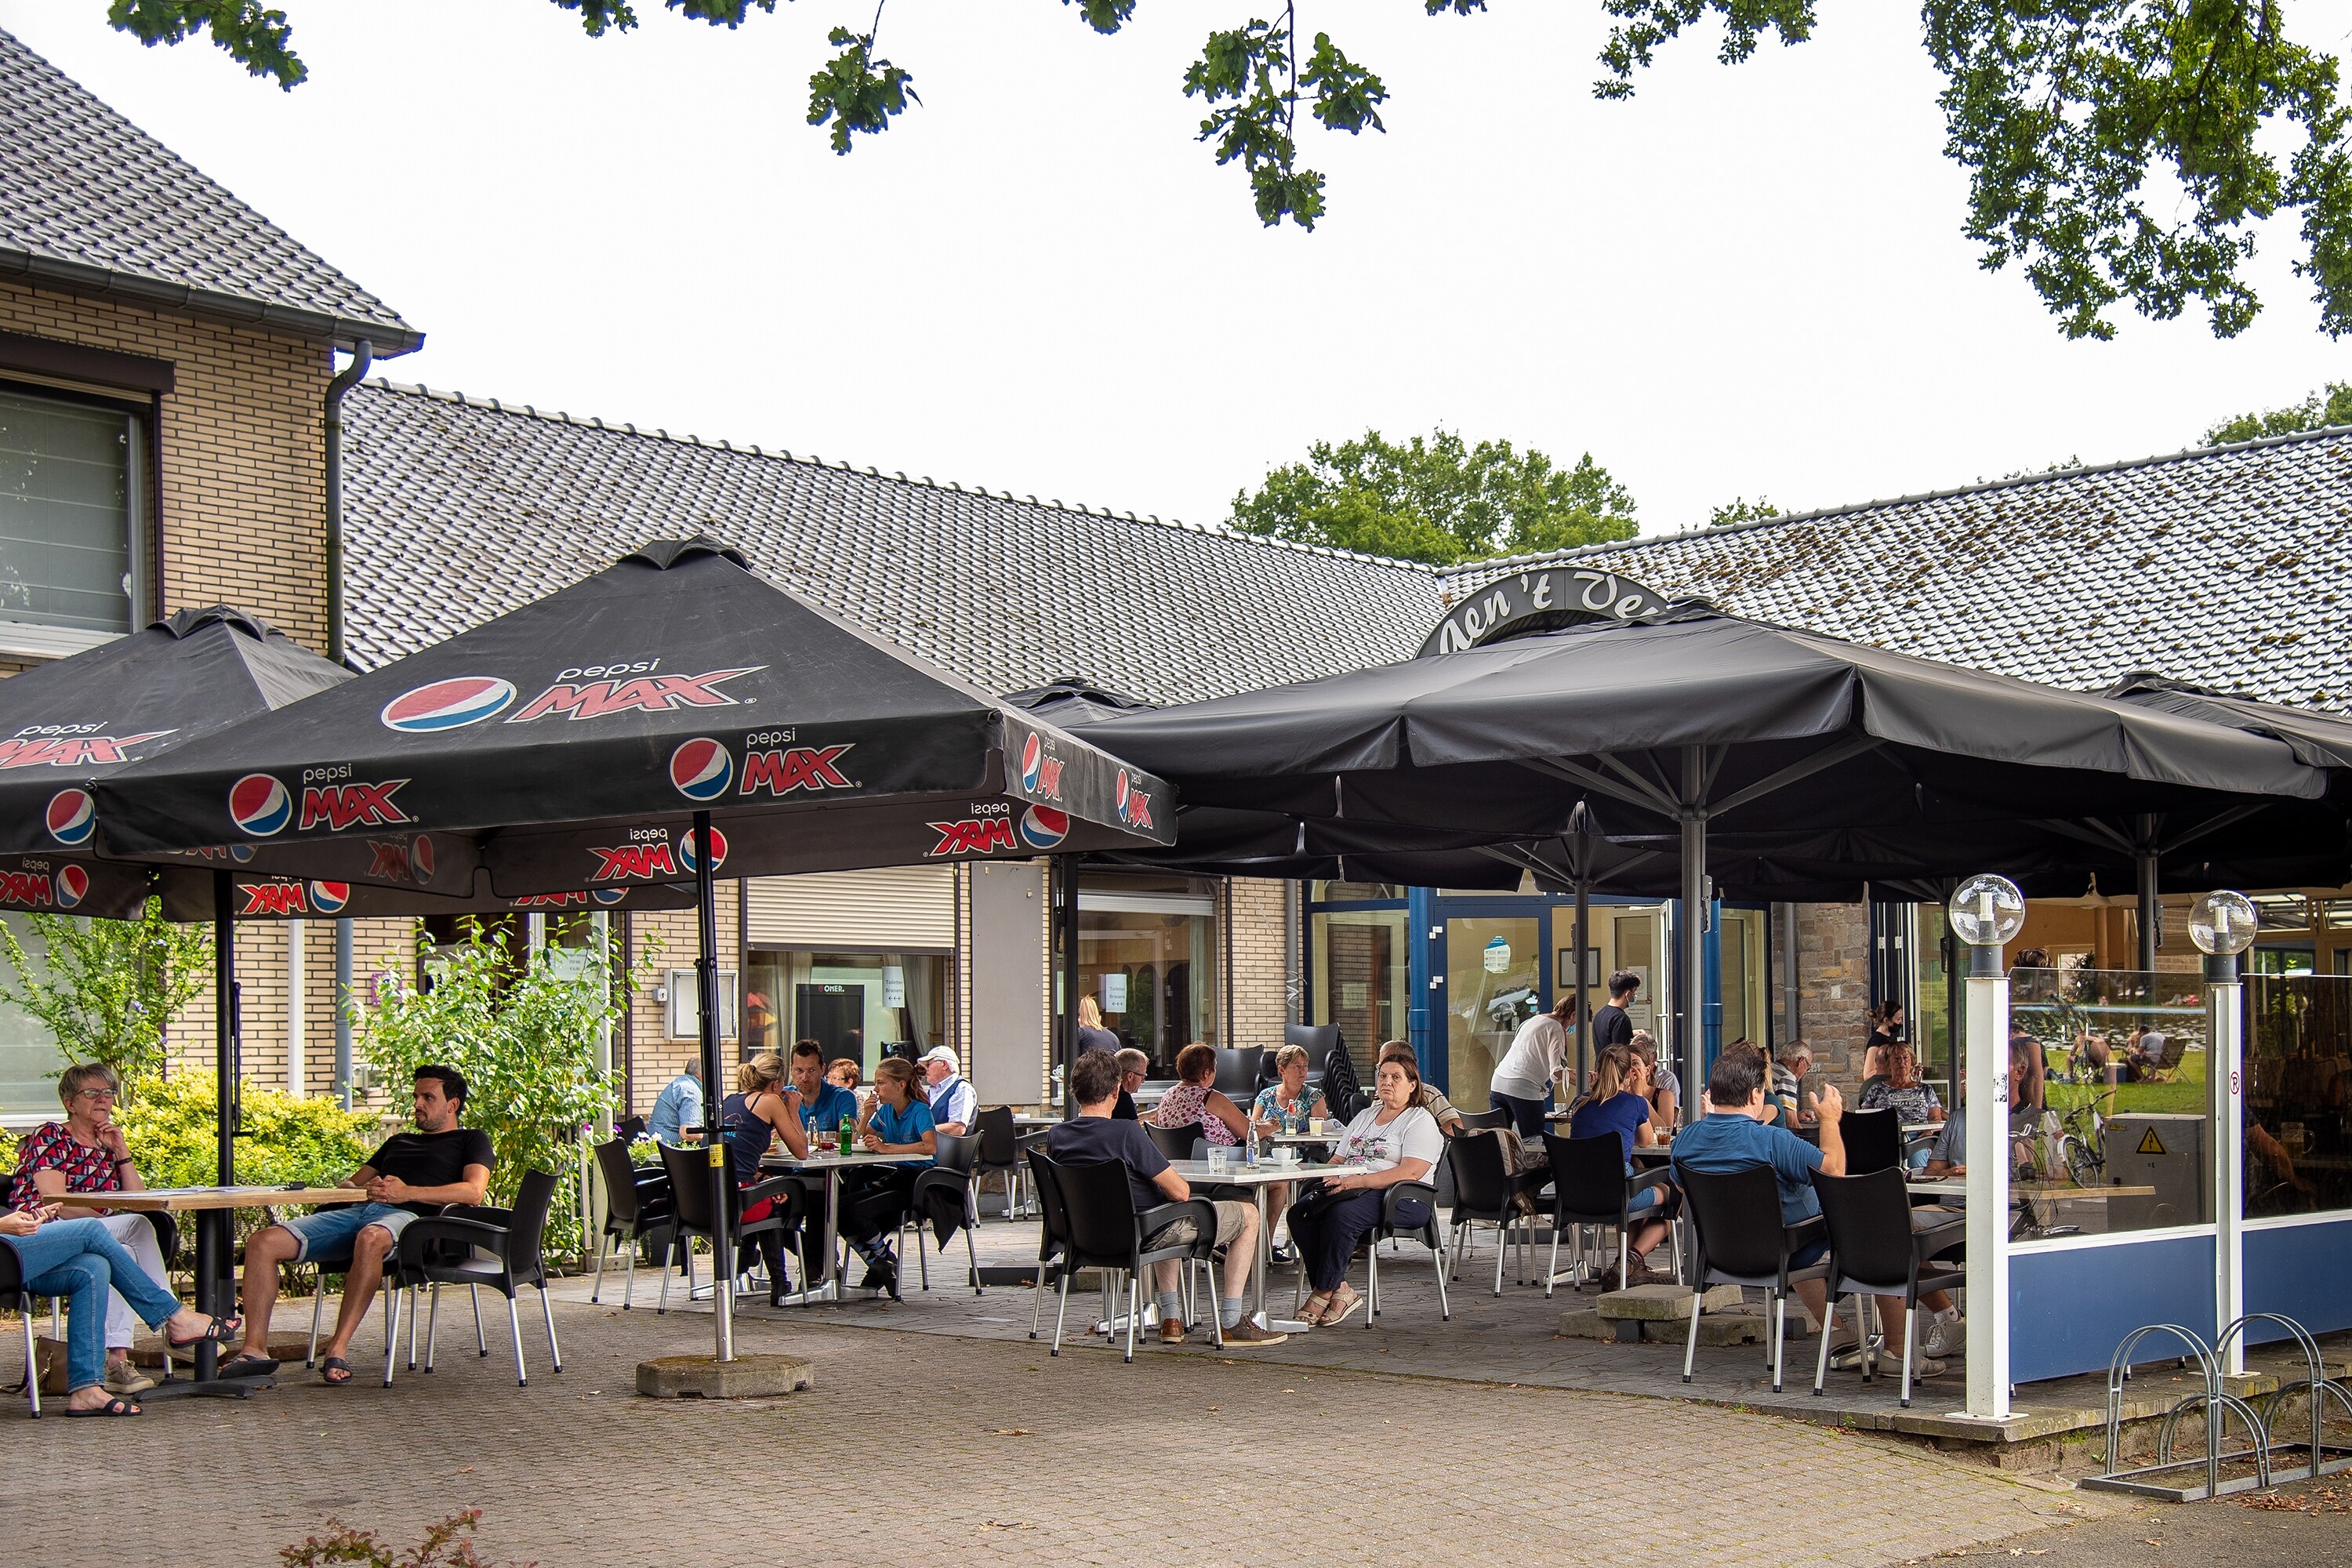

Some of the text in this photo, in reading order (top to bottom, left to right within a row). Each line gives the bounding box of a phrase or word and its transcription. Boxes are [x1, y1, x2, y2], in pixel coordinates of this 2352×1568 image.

[1520, 574, 1552, 609] 't
[555, 658, 661, 683] pepsi
[503, 665, 771, 724] MAX
[14, 721, 109, 738] pepsi
[746, 728, 796, 749] pepsi
[1044, 735, 1056, 753] pepsi
[0, 728, 181, 770] MAX
[303, 763, 352, 784] pepsi
[739, 743, 857, 797] MAX
[1036, 753, 1065, 803] MAX
[1131, 772, 1142, 787] pepsi
[299, 779, 412, 831] MAX
[1127, 787, 1154, 830] MAX
